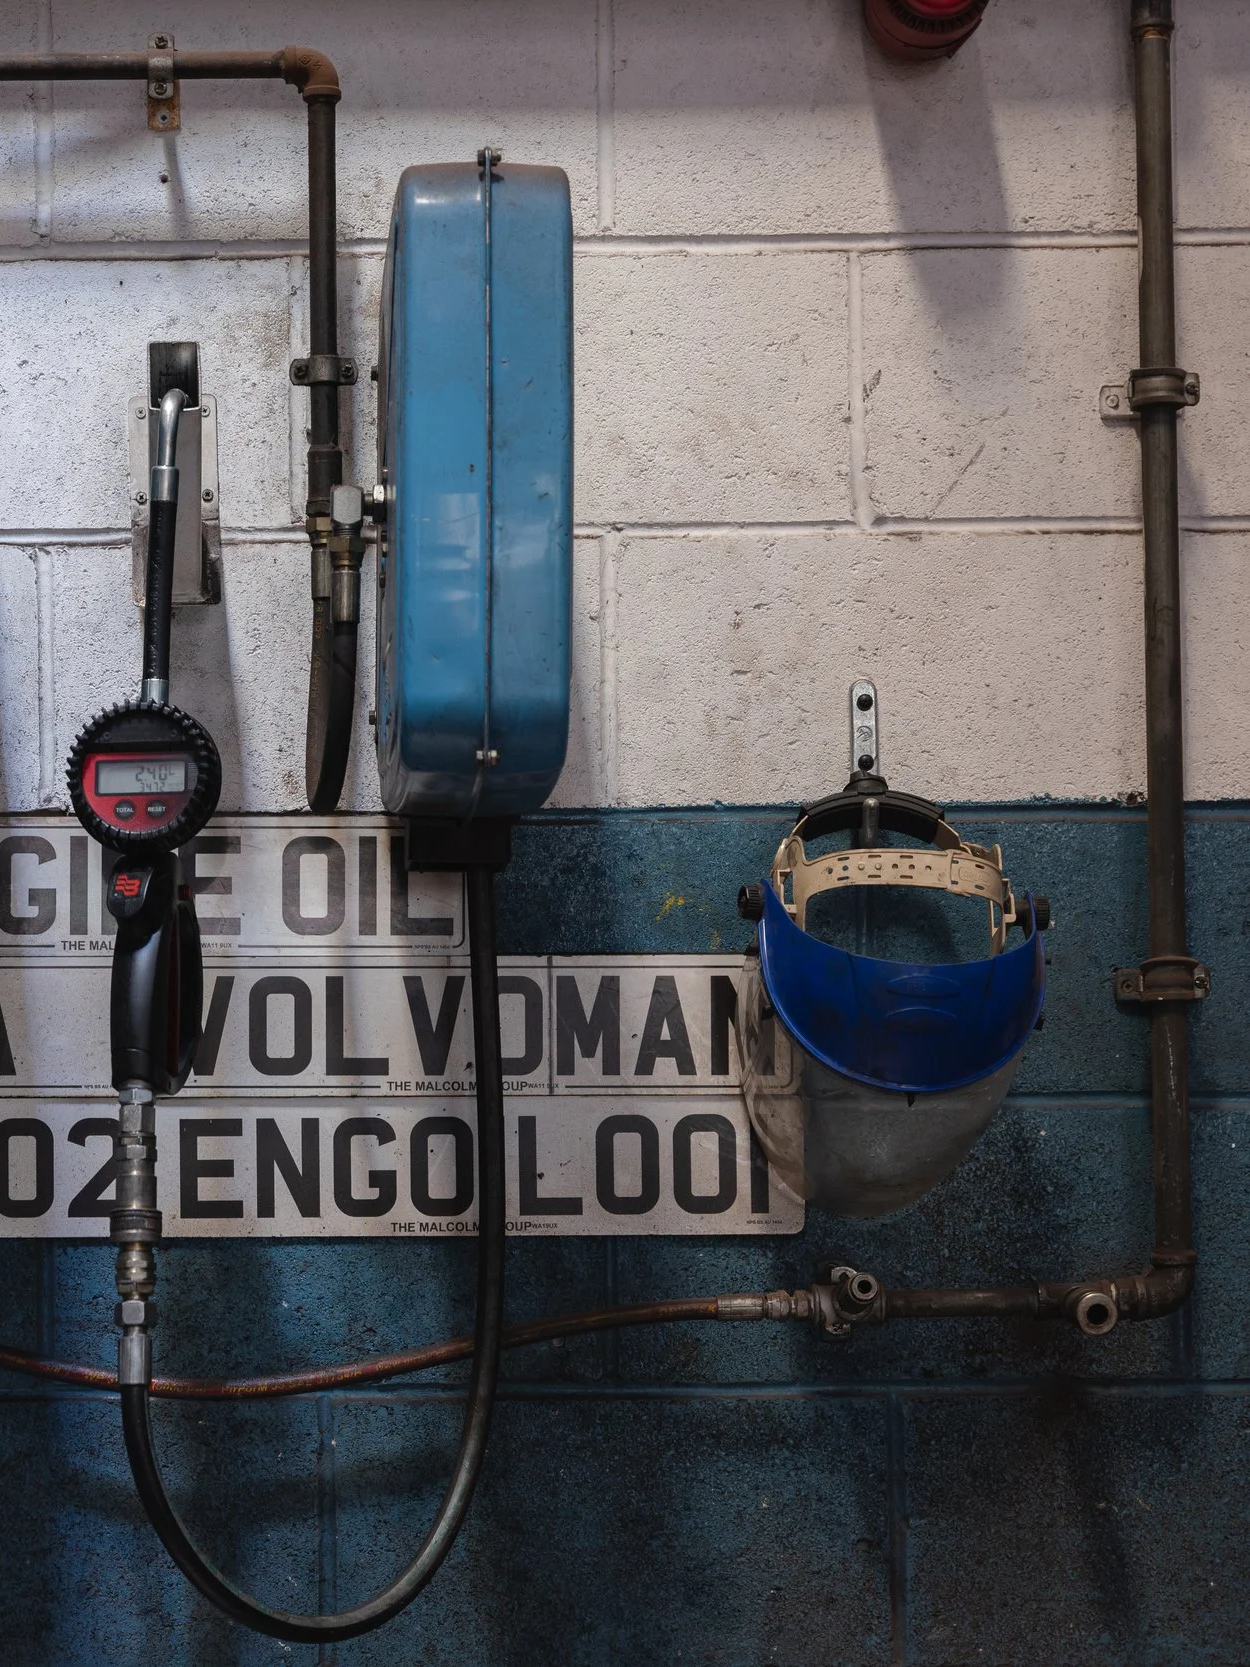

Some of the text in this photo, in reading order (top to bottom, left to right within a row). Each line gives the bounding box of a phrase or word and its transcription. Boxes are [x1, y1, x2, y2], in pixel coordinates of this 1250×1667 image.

[115, 806, 134, 814] TOTAL
[147, 805, 166, 813] RESET
[282, 836, 454, 936] OIL
[61, 940, 85, 951] THE
[556, 975, 776, 1076] MAN
[387, 1081, 411, 1091] THE
[415, 1081, 478, 1091] MALCOLM
[502, 1081, 528, 1091] OUP
[179, 1114, 769, 1219] ENGOL001
[391, 1222, 415, 1232] THE
[419, 1222, 479, 1232] MALCOLM
[505, 1221, 531, 1231] OUP
